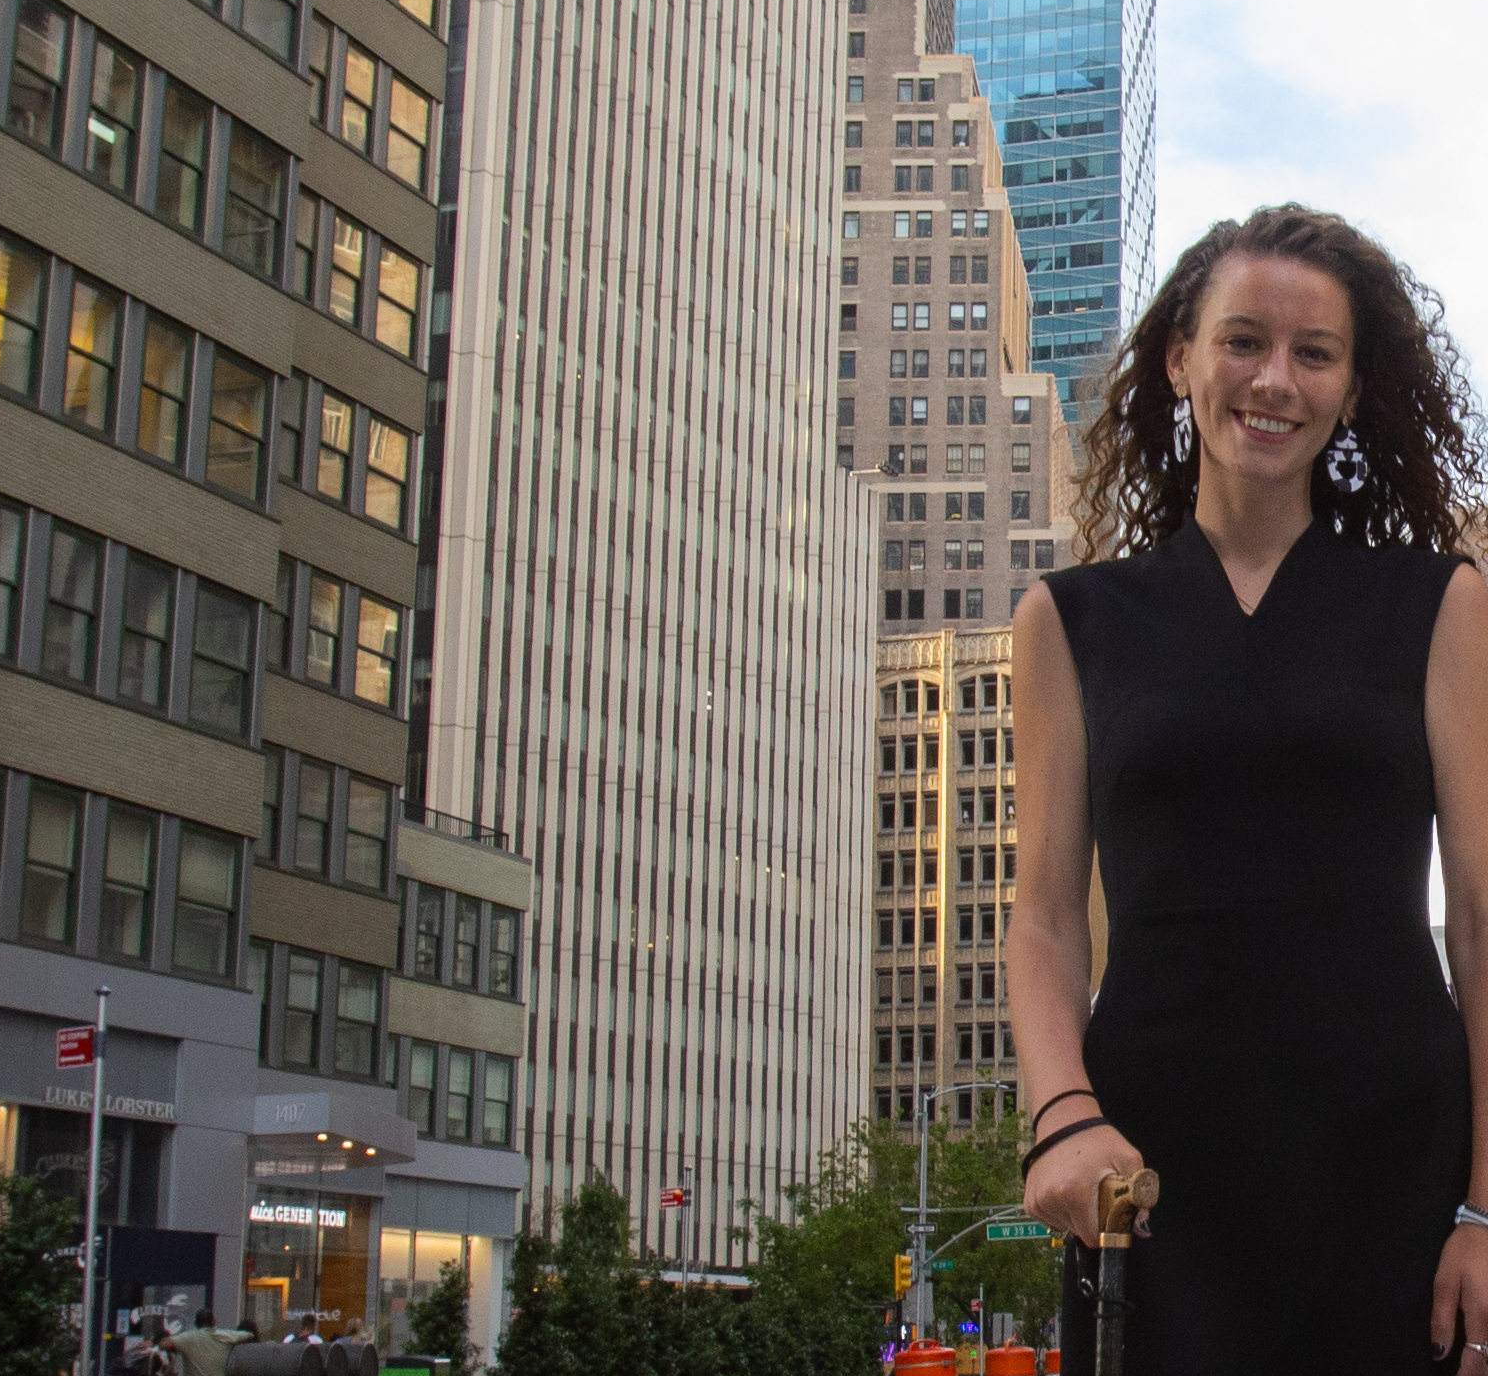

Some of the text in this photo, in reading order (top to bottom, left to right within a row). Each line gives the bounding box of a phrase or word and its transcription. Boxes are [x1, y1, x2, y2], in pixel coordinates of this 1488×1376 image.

[104, 1093, 175, 1120] LOBSTER
[275, 1205, 346, 1229] GENERTION
[1001, 1225, 1037, 1237] W 39 St
